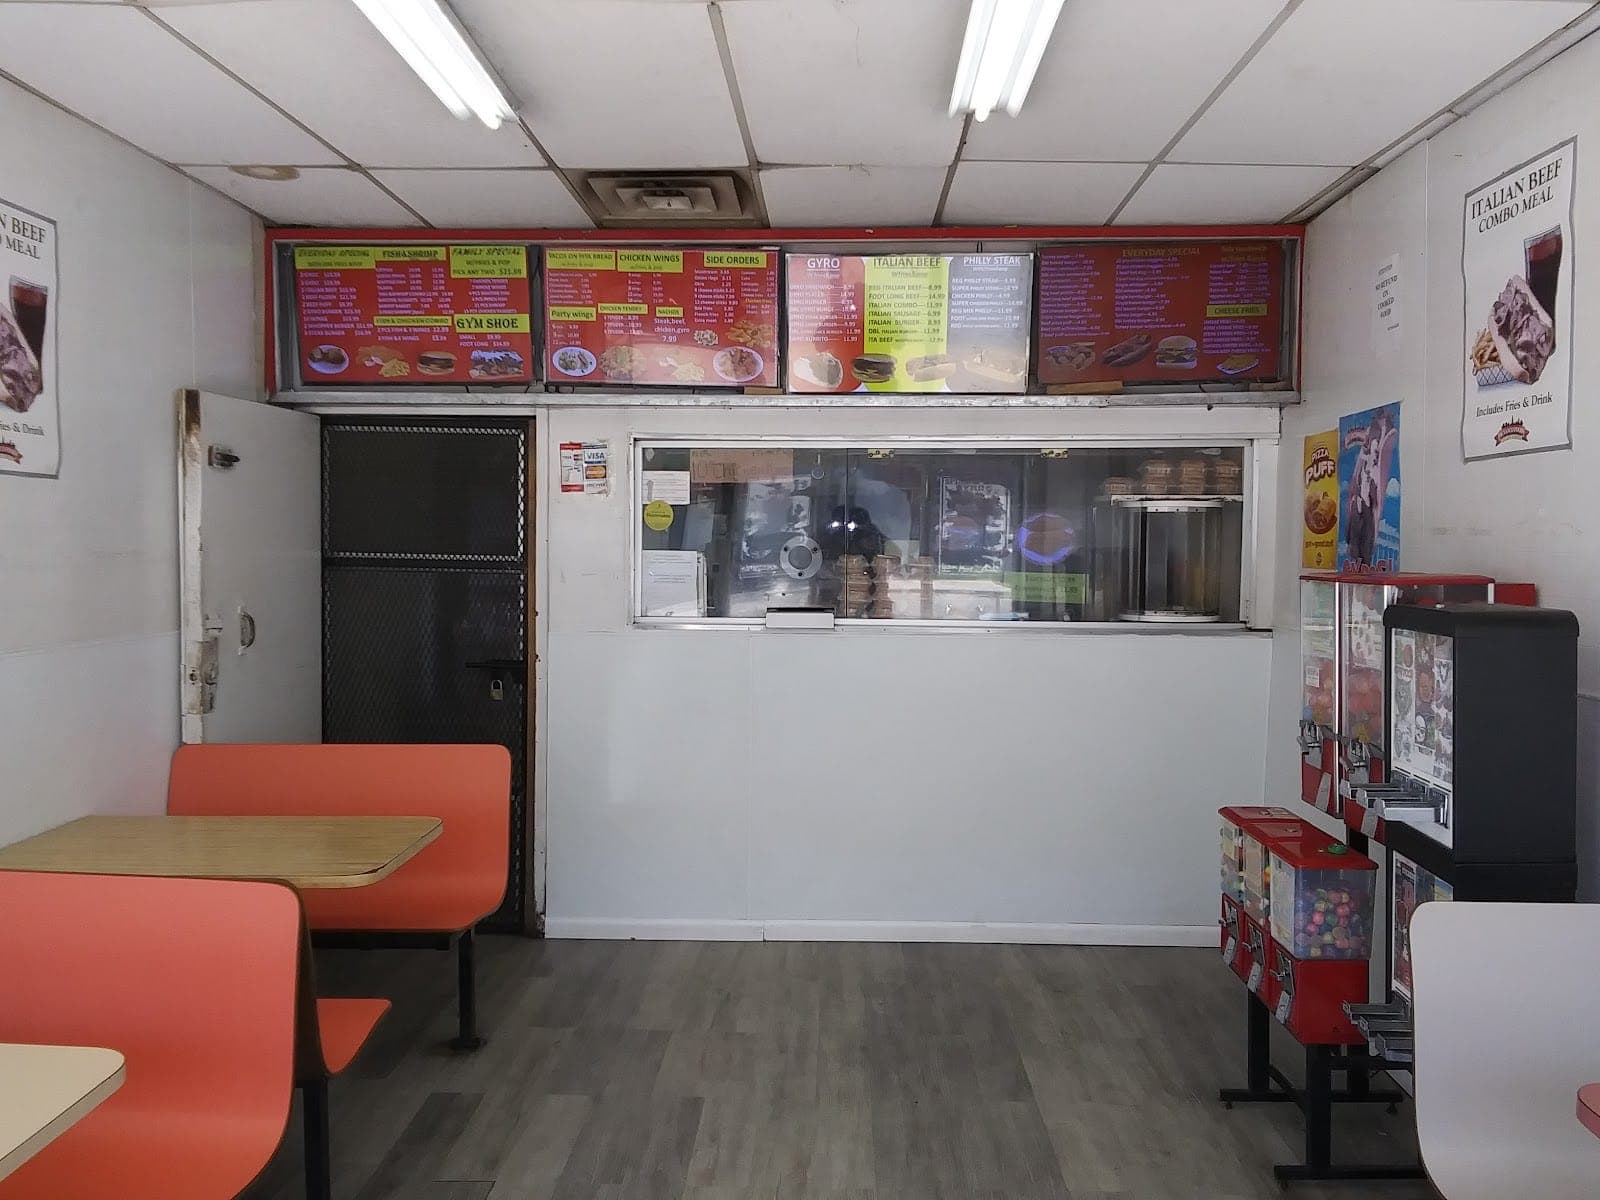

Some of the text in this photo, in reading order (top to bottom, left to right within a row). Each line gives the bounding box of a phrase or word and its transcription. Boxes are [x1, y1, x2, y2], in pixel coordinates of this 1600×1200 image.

[1471, 158, 1563, 220] ITALIAN BEEF
[1478, 186, 1554, 233] COMBO MEAL
[11, 217, 46, 243] BEEF
[5, 238, 41, 260] MEAL
[1122, 246, 1201, 257] EVERYDAY SPECIAL
[619, 254, 680, 263] CHICKEN WINGS
[706, 256, 760, 266] SIDE ORDERS
[807, 257, 841, 269] GYRO
[873, 257, 941, 267] ITALIAN BEEF
[963, 256, 1021, 265] PHILLY STEAK
[551, 311, 593, 320] Party wings
[456, 317, 519, 329] GYM SHOE
[1476, 391, 1553, 417] Includes Fries & Drink
[12, 422, 21, 432] &
[23, 423, 45, 436] Drink
[587, 452, 606, 460] VISA
[1311, 448, 1329, 462] PIZZA
[1305, 459, 1336, 489] PUFF
